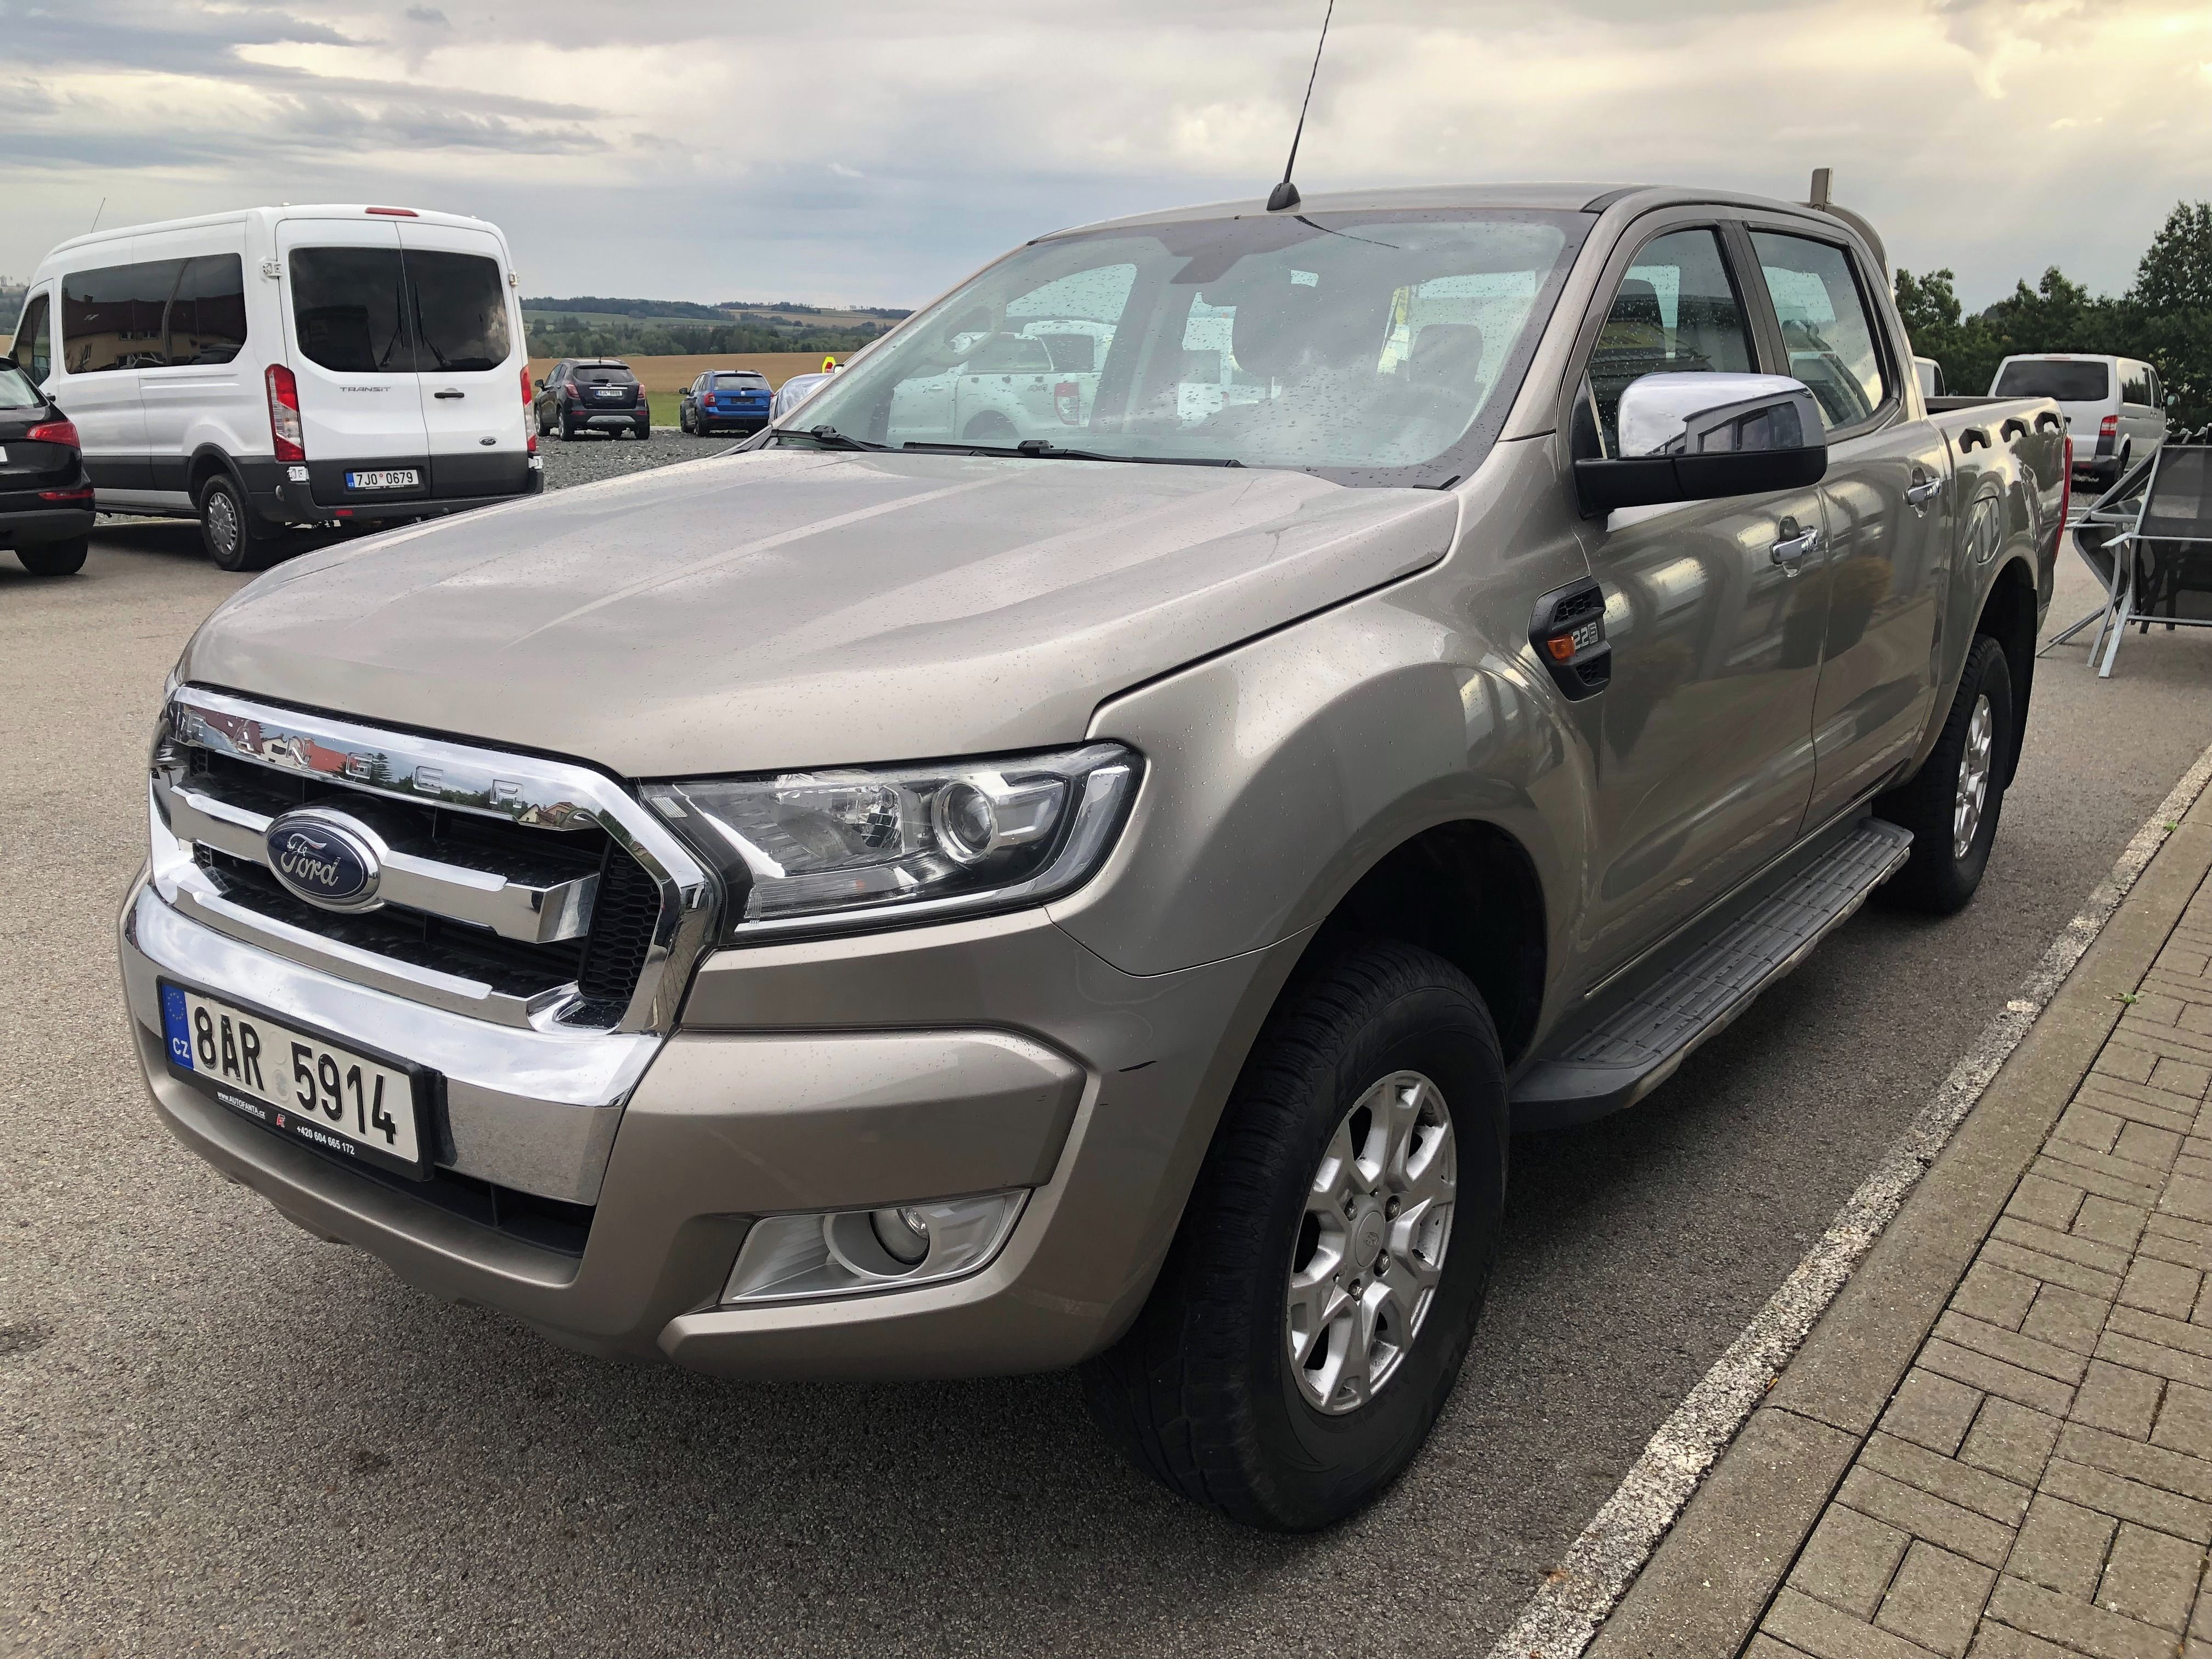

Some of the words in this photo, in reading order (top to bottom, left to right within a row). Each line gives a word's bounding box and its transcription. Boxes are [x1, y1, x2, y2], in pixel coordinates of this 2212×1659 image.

[356, 473, 378, 486] 7J0
[386, 472, 413, 484] 0679
[185, 710, 525, 809] RANGER
[280, 833, 341, 887] Ford
[172, 1037, 190, 1059] CZ
[194, 1006, 265, 1092] 8AR
[291, 1041, 397, 1146] 5914
[296, 1125, 313, 1139] +420
[314, 1130, 327, 1144] 604
[328, 1136, 341, 1150] 665
[342, 1142, 355, 1155] 172
